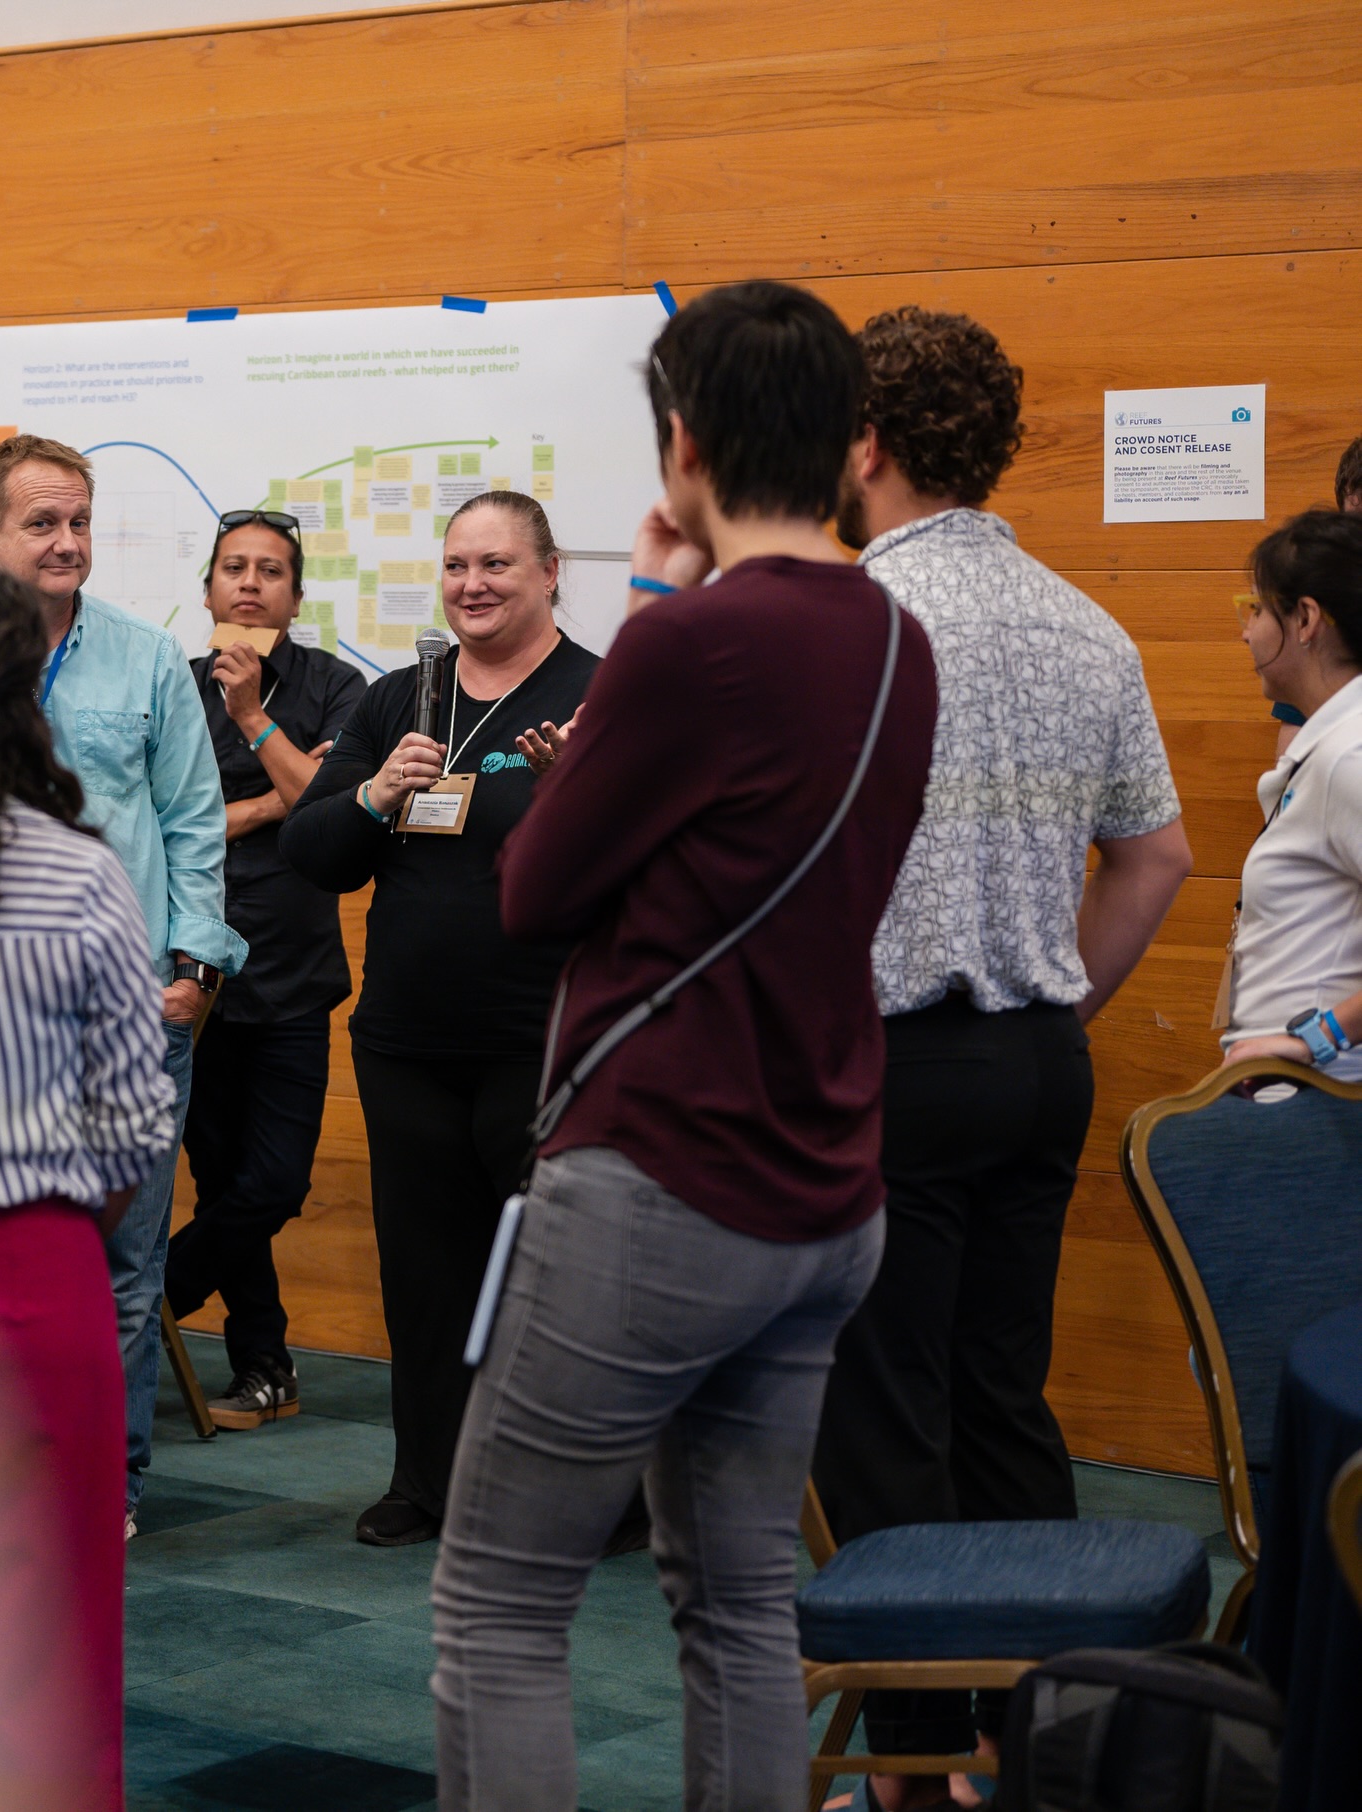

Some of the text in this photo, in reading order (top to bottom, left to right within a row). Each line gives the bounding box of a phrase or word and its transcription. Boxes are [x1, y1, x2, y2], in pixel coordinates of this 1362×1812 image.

[246, 355, 283, 366] Horizon
[343, 351, 369, 361] world
[371, 351, 381, 361] in
[383, 349, 412, 360] which
[414, 350, 429, 358] we
[430, 347, 454, 358] have
[456, 345, 507, 357] succeeded
[509, 344, 519, 355] in
[64, 362, 85, 372] What
[102, 362, 116, 371] the
[172, 358, 189, 368] and
[246, 371, 285, 383] rescuing
[287, 369, 335, 380] Caribbean
[337, 368, 361, 379] coral
[362, 367, 387, 378] reefs
[394, 366, 419, 376] what
[421, 364, 454, 377] helped
[456, 366, 468, 374] us
[469, 364, 485, 376] get
[487, 361, 520, 373] there?
[79, 379, 111, 390] practice
[126, 376, 154, 386] should
[194, 376, 204, 384] to
[23, 396, 56, 407] respond
[80, 394, 96, 404] and
[1129, 418, 1162, 426] FUTURES
[1114, 434, 1197, 445] CROWD NOTICE
[1114, 443, 1232, 456] AND COSENT RELEASE
[505, 753, 531, 769] CORAL
